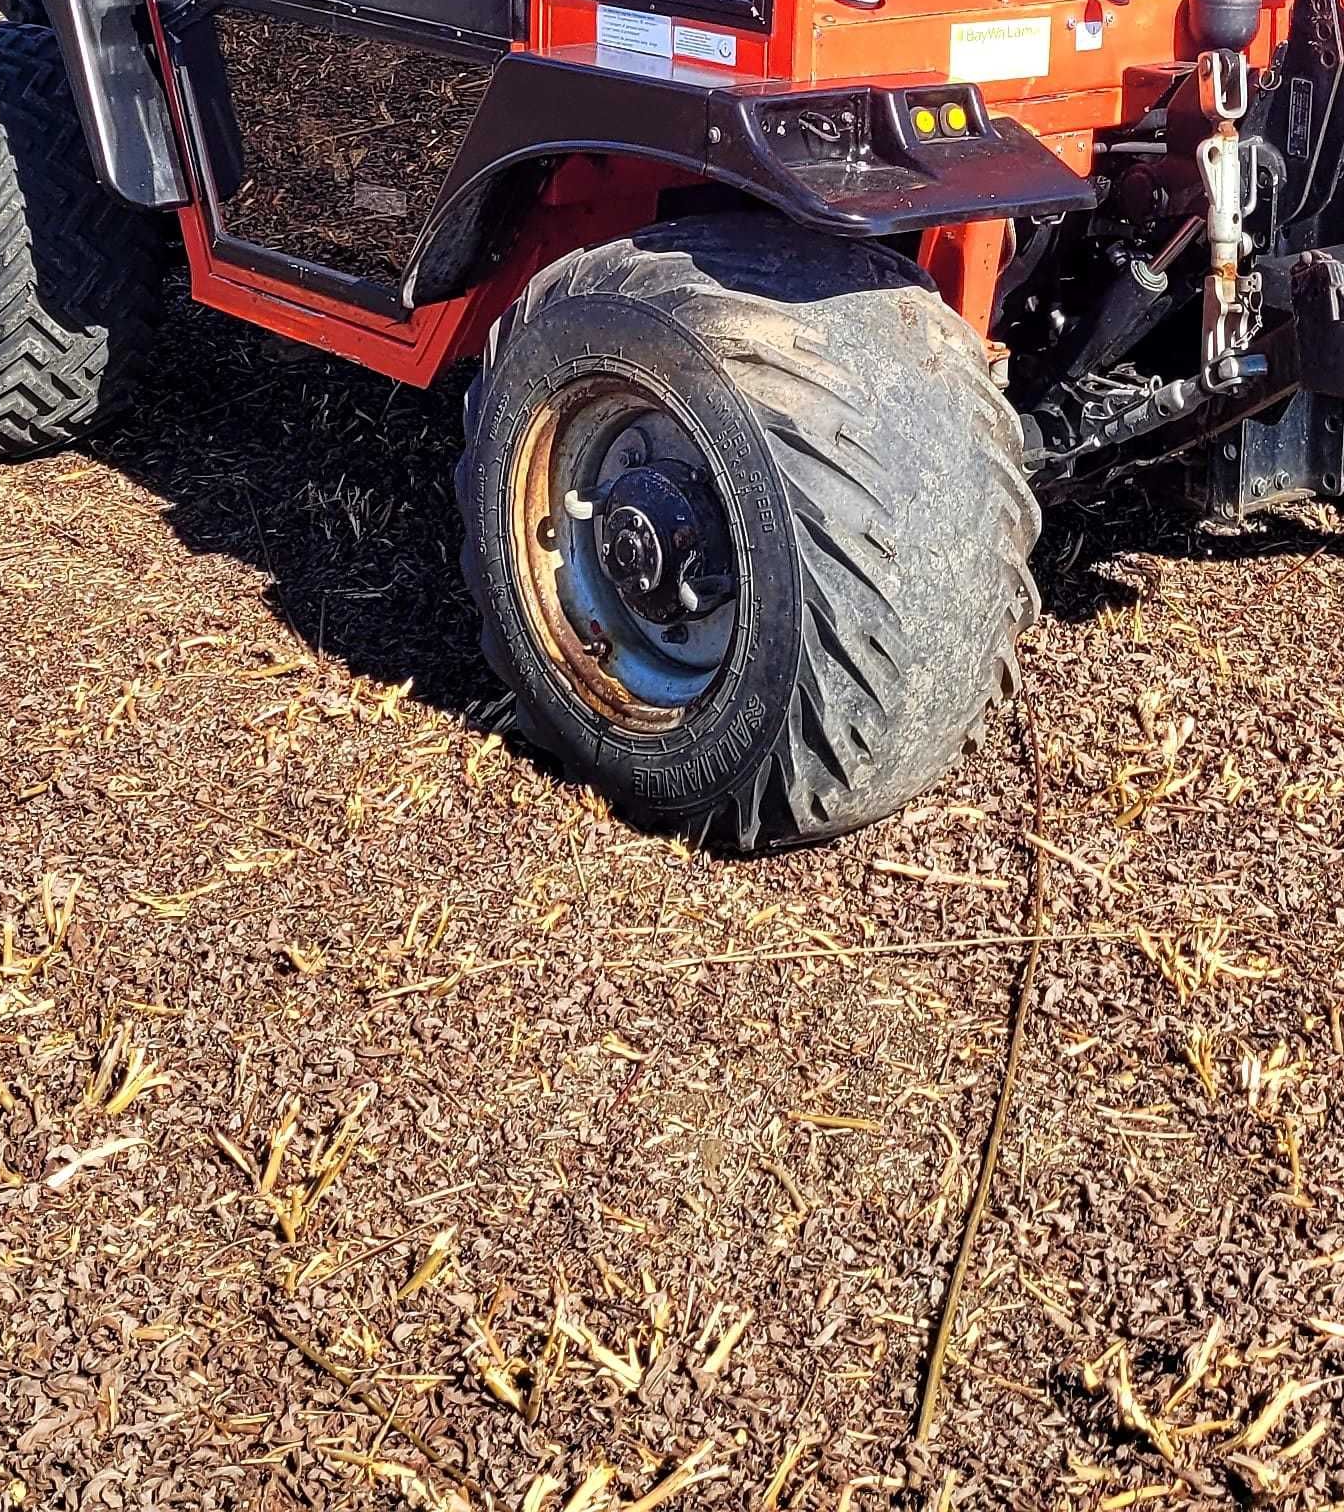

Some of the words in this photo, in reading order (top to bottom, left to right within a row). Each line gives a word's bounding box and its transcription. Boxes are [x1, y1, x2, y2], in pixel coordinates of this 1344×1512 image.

[706, 388, 751, 458] LIMITED
[749, 471, 776, 534] SPEED
[632, 709, 753, 799] ALLIANCE
